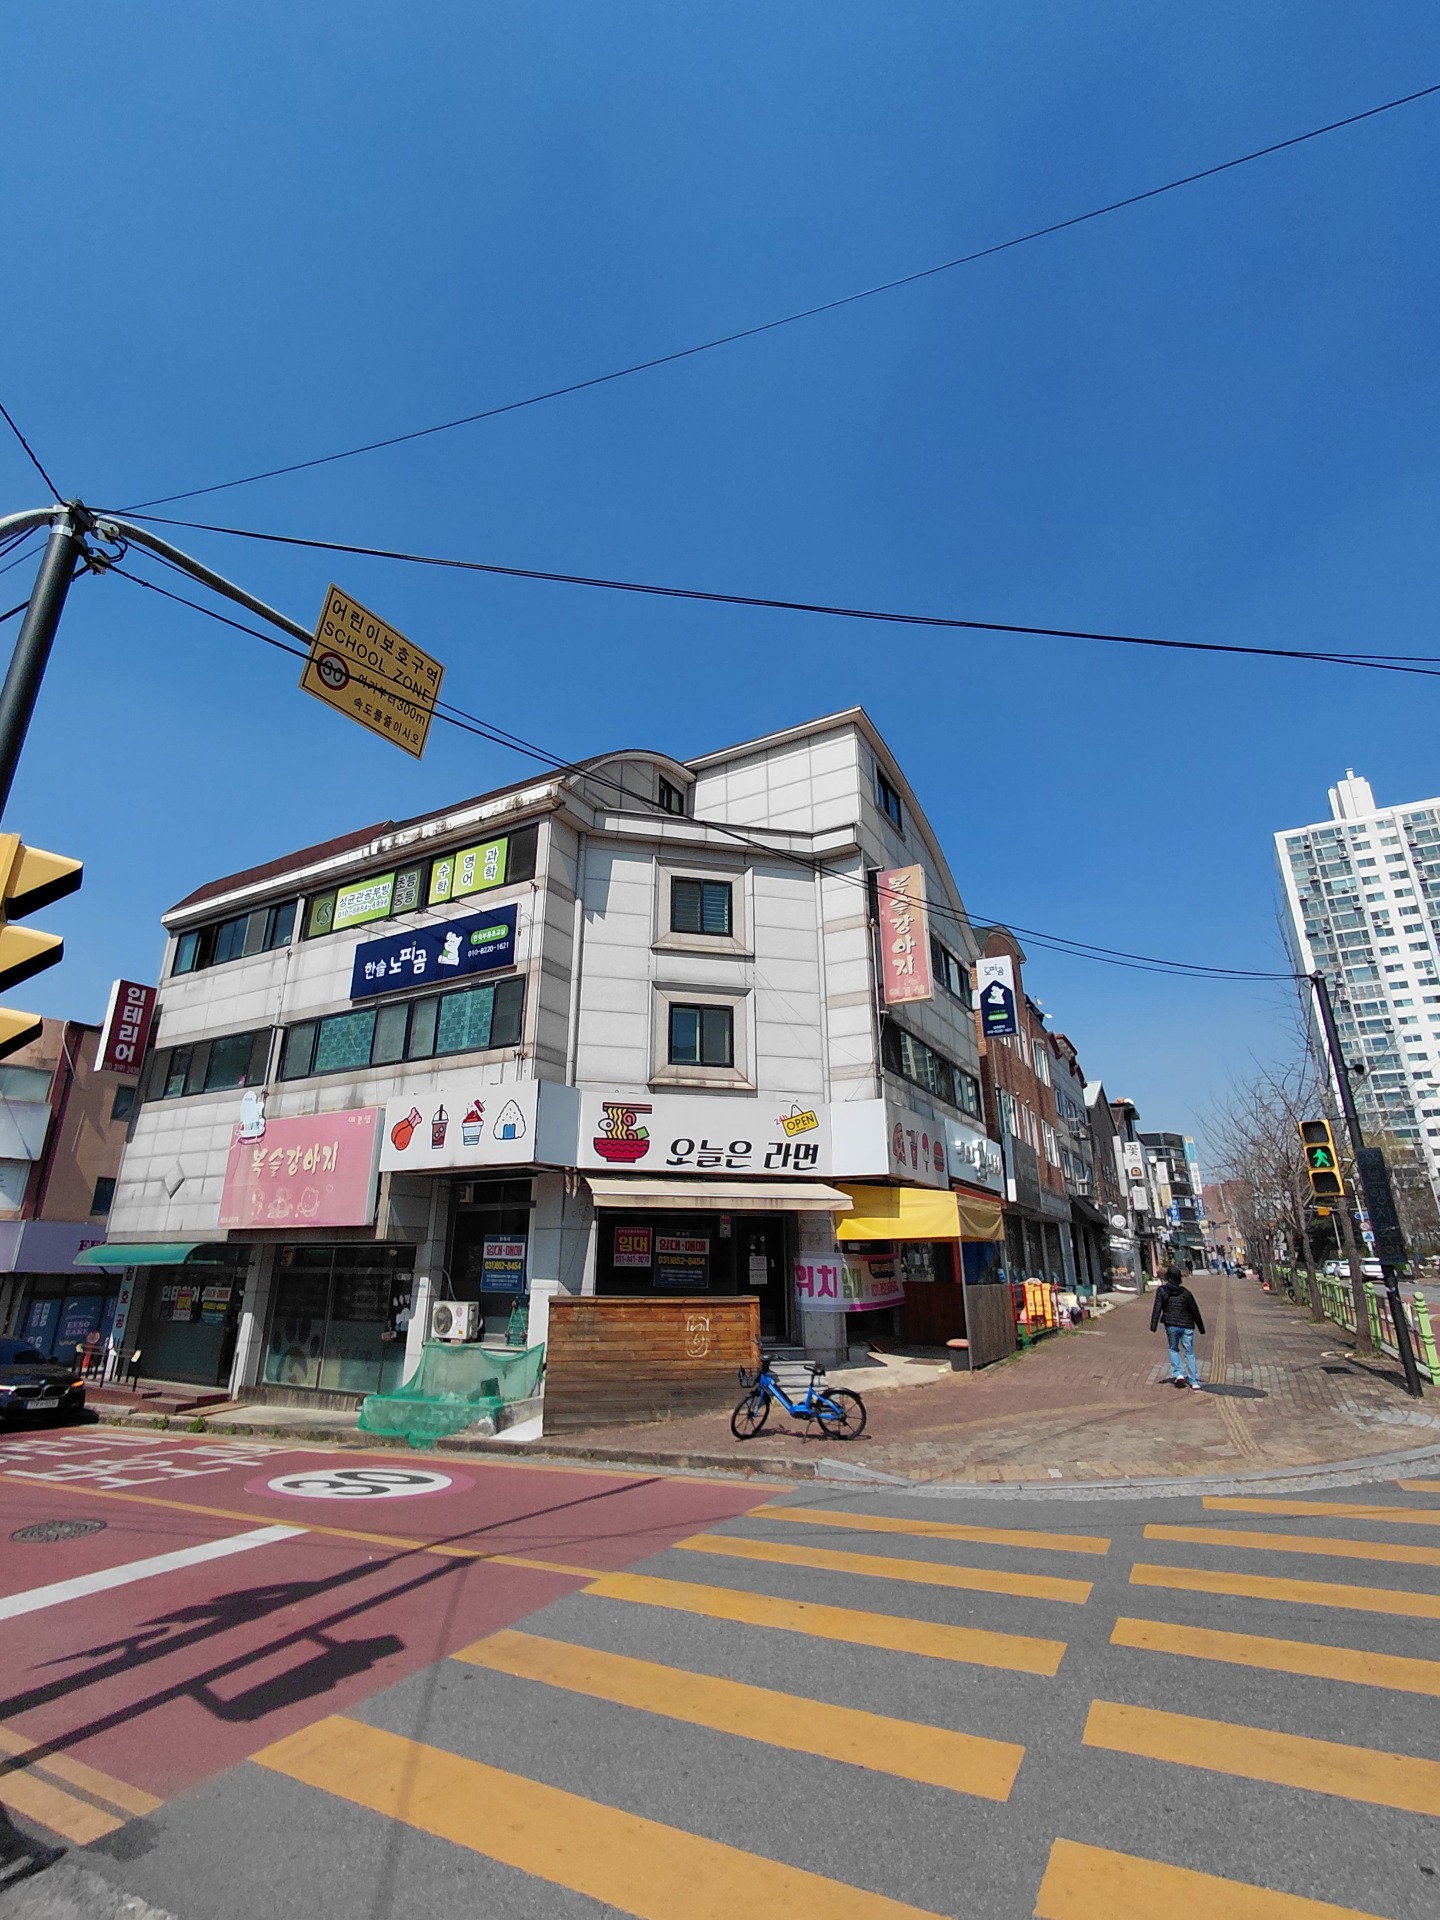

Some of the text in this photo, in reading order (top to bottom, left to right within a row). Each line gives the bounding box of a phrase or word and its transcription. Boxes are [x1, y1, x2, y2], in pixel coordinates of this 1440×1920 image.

[332, 599, 438, 688] 어린이보호구역
[322, 660, 343, 683] 30
[324, 621, 431, 703] SCHOOL ZONE
[436, 863, 451, 894] 수학
[462, 853, 475, 886] 영어
[485, 848, 499, 880] 과학
[340, 883, 390, 908] 성균관공부방
[364, 943, 428, 980] 한솔 노피곰
[115, 987, 147, 1062] 인테리어
[773, 1114, 789, 1126] 24h
[786, 1113, 815, 1132] OPEN
[251, 1140, 339, 1178] 복슬강아지
[665, 1138, 819, 1171] 오늘은 라면
[618, 1236, 648, 1252] 임대
[794, 1264, 838, 1298] 위치
[283, 1470, 435, 1495] 30
